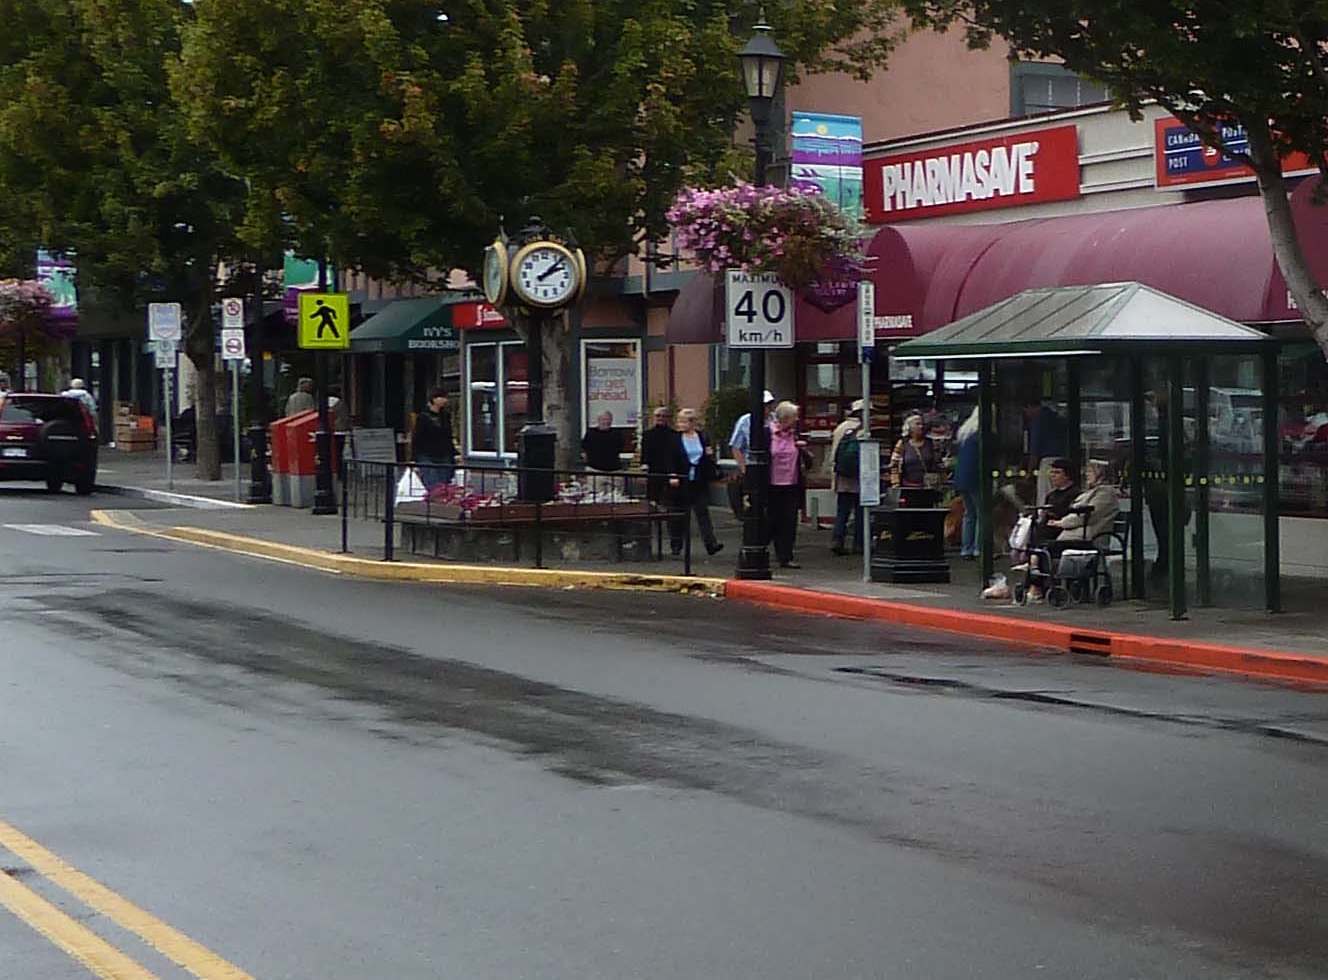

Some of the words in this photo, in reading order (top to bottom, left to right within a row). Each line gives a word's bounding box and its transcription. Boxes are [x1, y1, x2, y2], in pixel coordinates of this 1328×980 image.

[1169, 156, 1188, 170] POST
[882, 142, 1036, 212] PHARMASAVE
[732, 273, 780, 285] MAXIMU
[734, 289, 786, 324] 40
[738, 329, 783, 342] km/h
[408, 339, 461, 349] BOOKSHO
